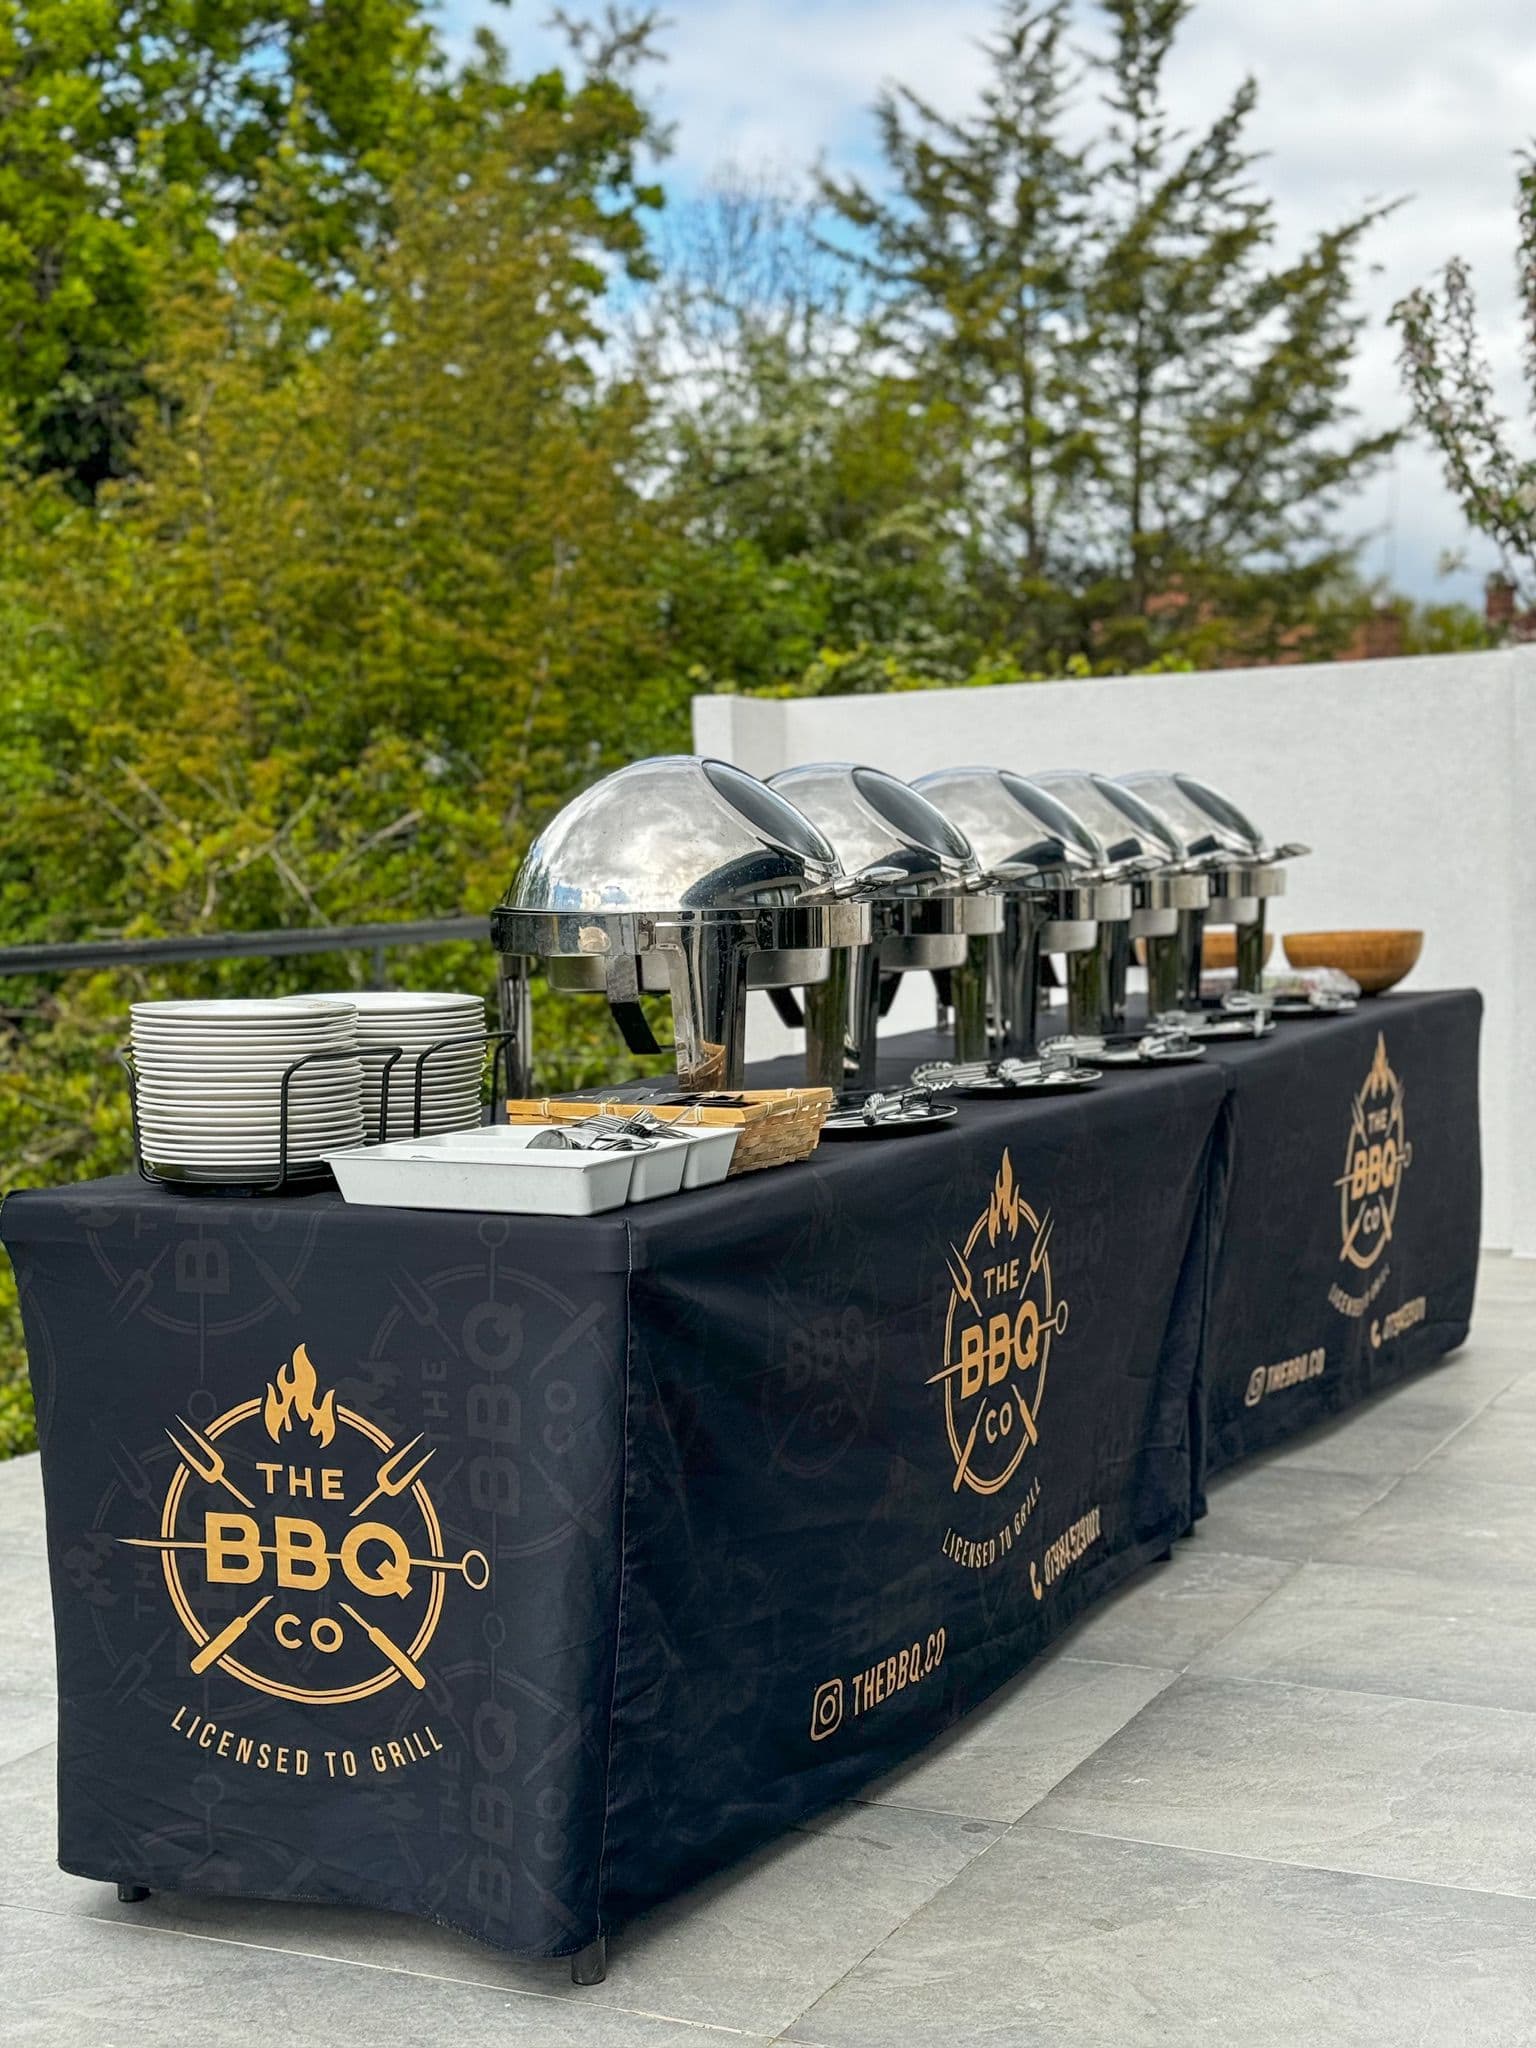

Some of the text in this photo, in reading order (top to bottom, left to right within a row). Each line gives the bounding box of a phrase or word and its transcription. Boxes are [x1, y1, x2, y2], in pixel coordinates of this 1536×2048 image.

[1367, 1107, 1389, 1135] THE
[1351, 1138, 1397, 1201] BBQ
[1362, 1206, 1381, 1235] CO
[984, 1258, 1020, 1299] THE
[961, 1301, 1040, 1400] BBQ
[986, 1402, 1012, 1443] CO
[256, 1462, 345, 1500] THE
[942, 1476, 1041, 1568] LICENSED TO GRILL
[205, 1511, 413, 1600] BBQ
[275, 1613, 344, 1653] CO
[852, 1627, 946, 1716] THEBBQ.CO
[171, 1705, 443, 1778] LICENSED TO GRILL
